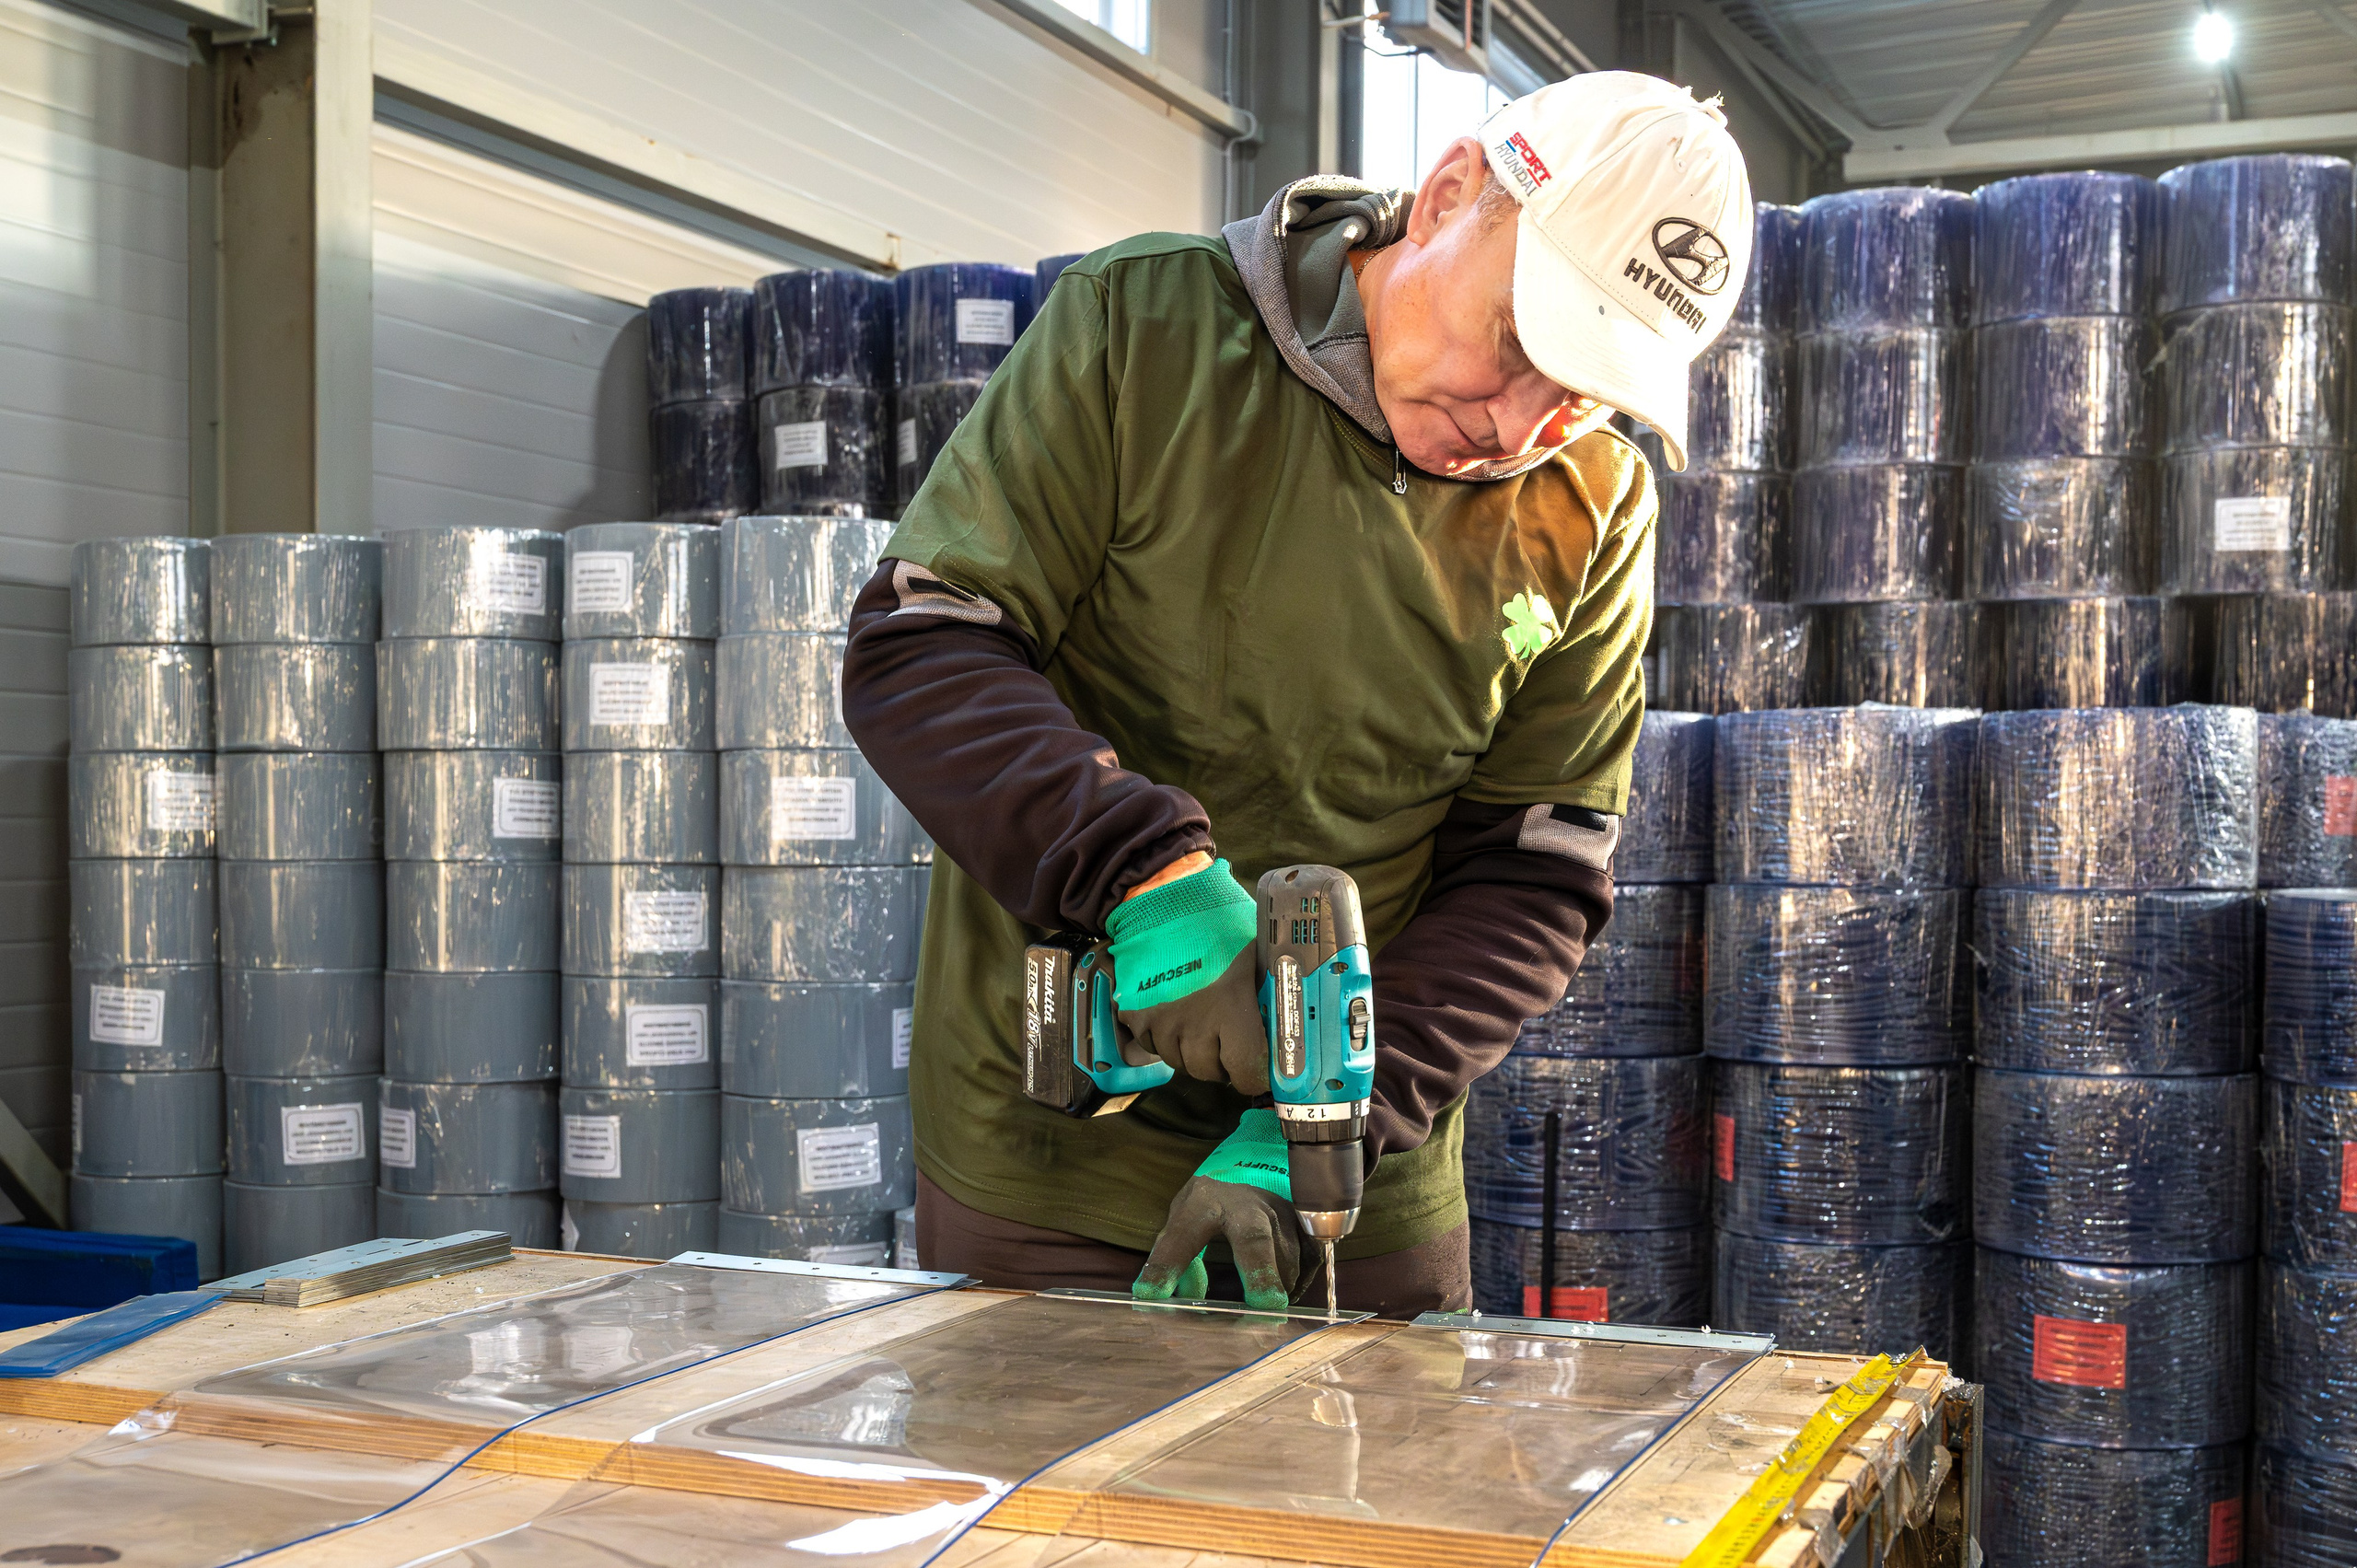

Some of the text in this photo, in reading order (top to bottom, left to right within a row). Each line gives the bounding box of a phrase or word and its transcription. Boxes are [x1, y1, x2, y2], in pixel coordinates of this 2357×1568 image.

[1494, 143, 1538, 198] HYUNDAI
[1509, 132, 1552, 182] SPORT
[1623, 257, 1708, 335] HYUNDAI
[1137, 958, 1202, 993] NESCUFFY
